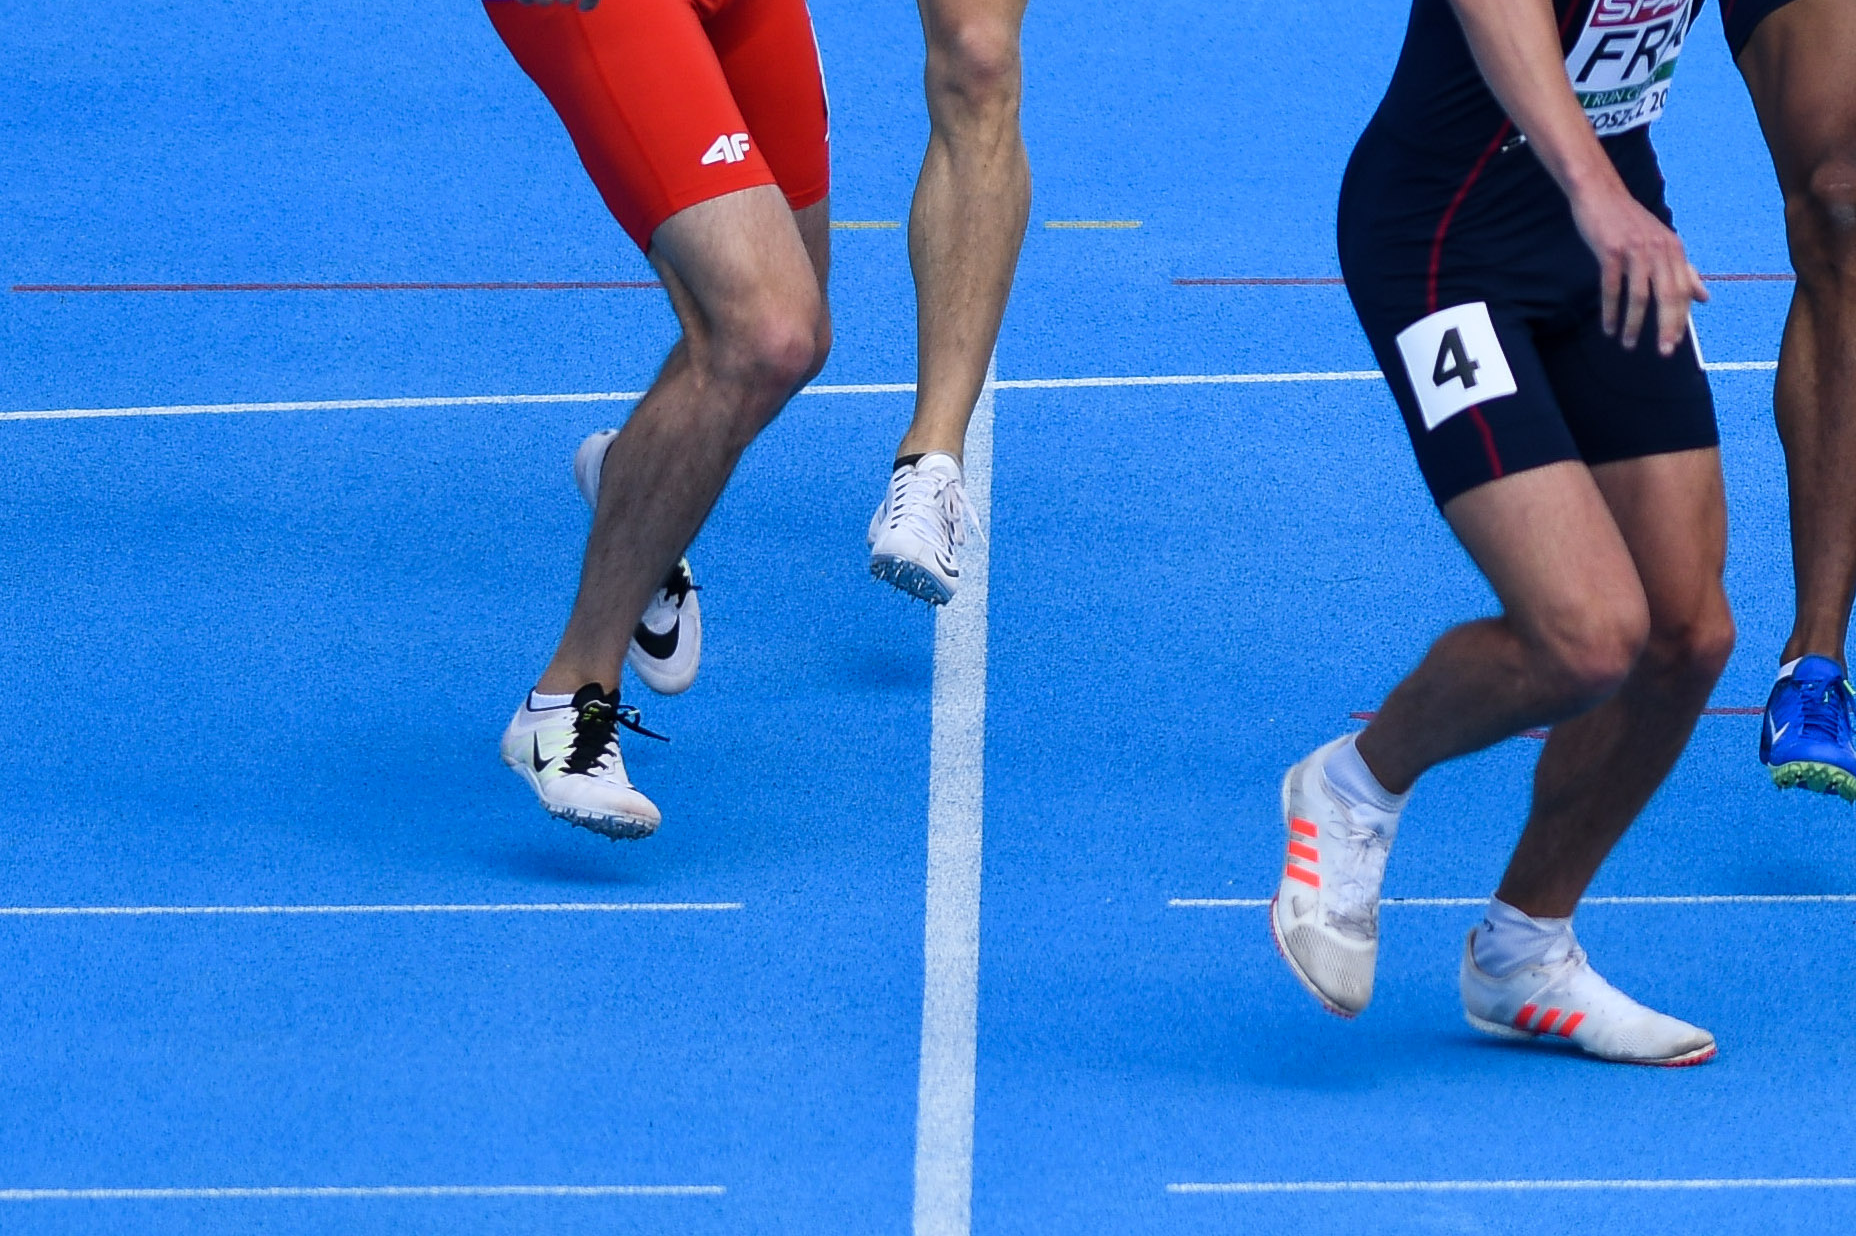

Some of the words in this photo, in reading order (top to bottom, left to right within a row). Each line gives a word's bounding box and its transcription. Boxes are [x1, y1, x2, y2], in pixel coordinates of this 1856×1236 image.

[1575, 0, 1690, 83] FRA
[1593, 89, 1625, 107] RUN
[701, 133, 750, 165] 4F
[1432, 327, 1480, 389] 4
